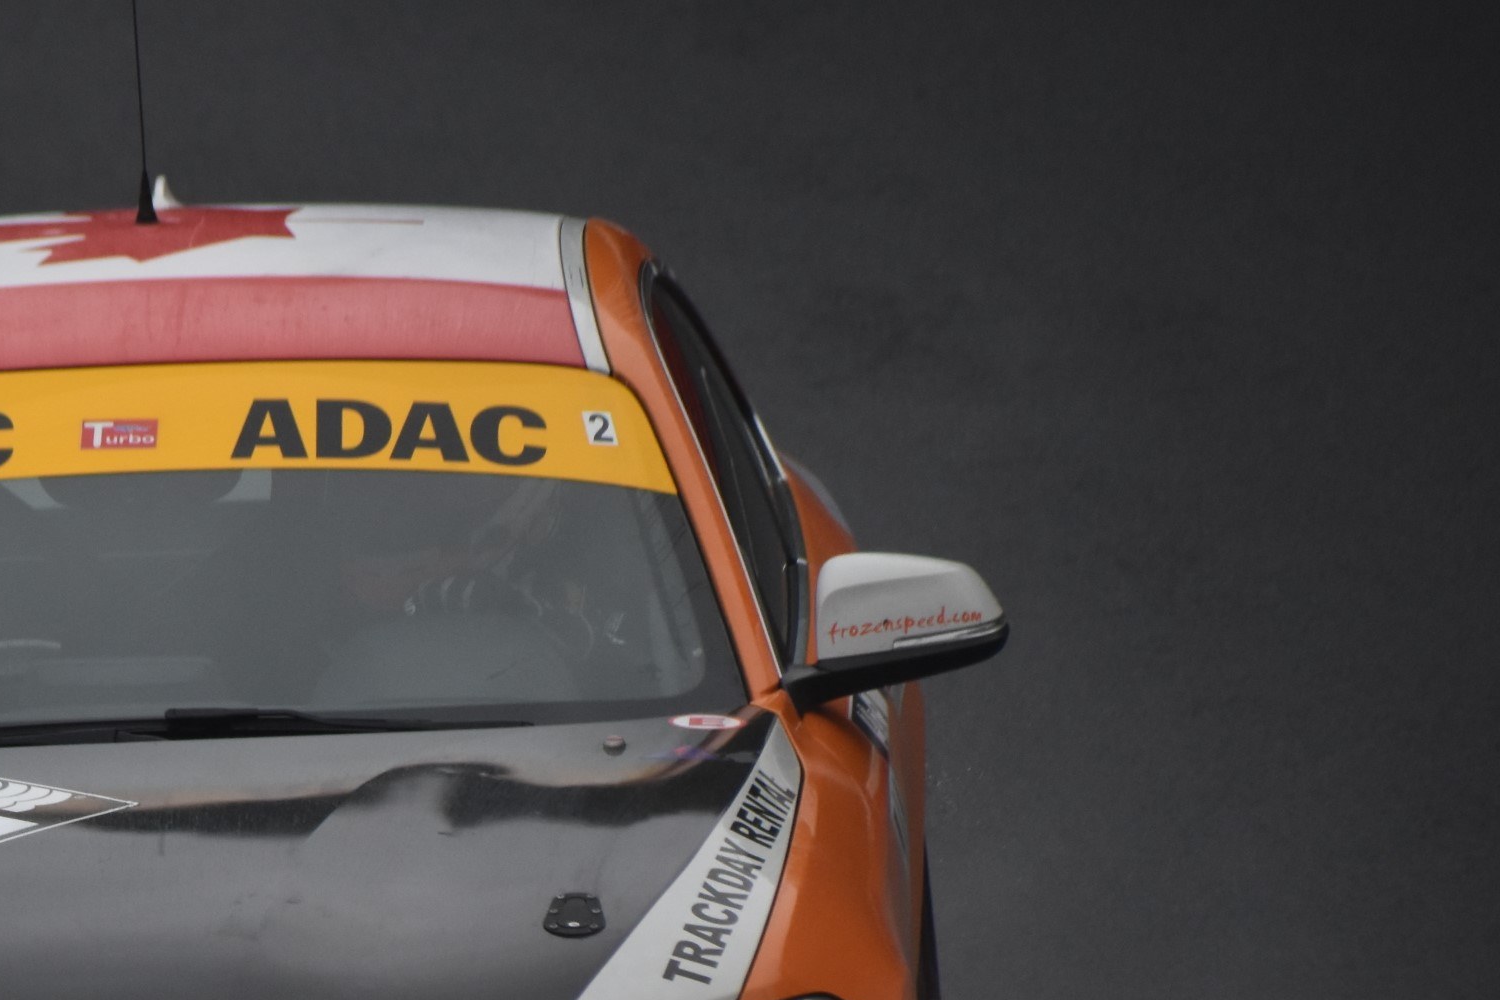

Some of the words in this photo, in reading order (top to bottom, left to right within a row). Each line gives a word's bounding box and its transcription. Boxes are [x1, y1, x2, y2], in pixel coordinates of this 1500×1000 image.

[83, 421, 155, 449] Turbo
[231, 398, 547, 466] ADAC
[588, 413, 614, 443] 2
[829, 605, 982, 645] frozenspeed.com
[662, 838, 766, 985] TRACKDAY
[730, 770, 797, 849] RENTAL
